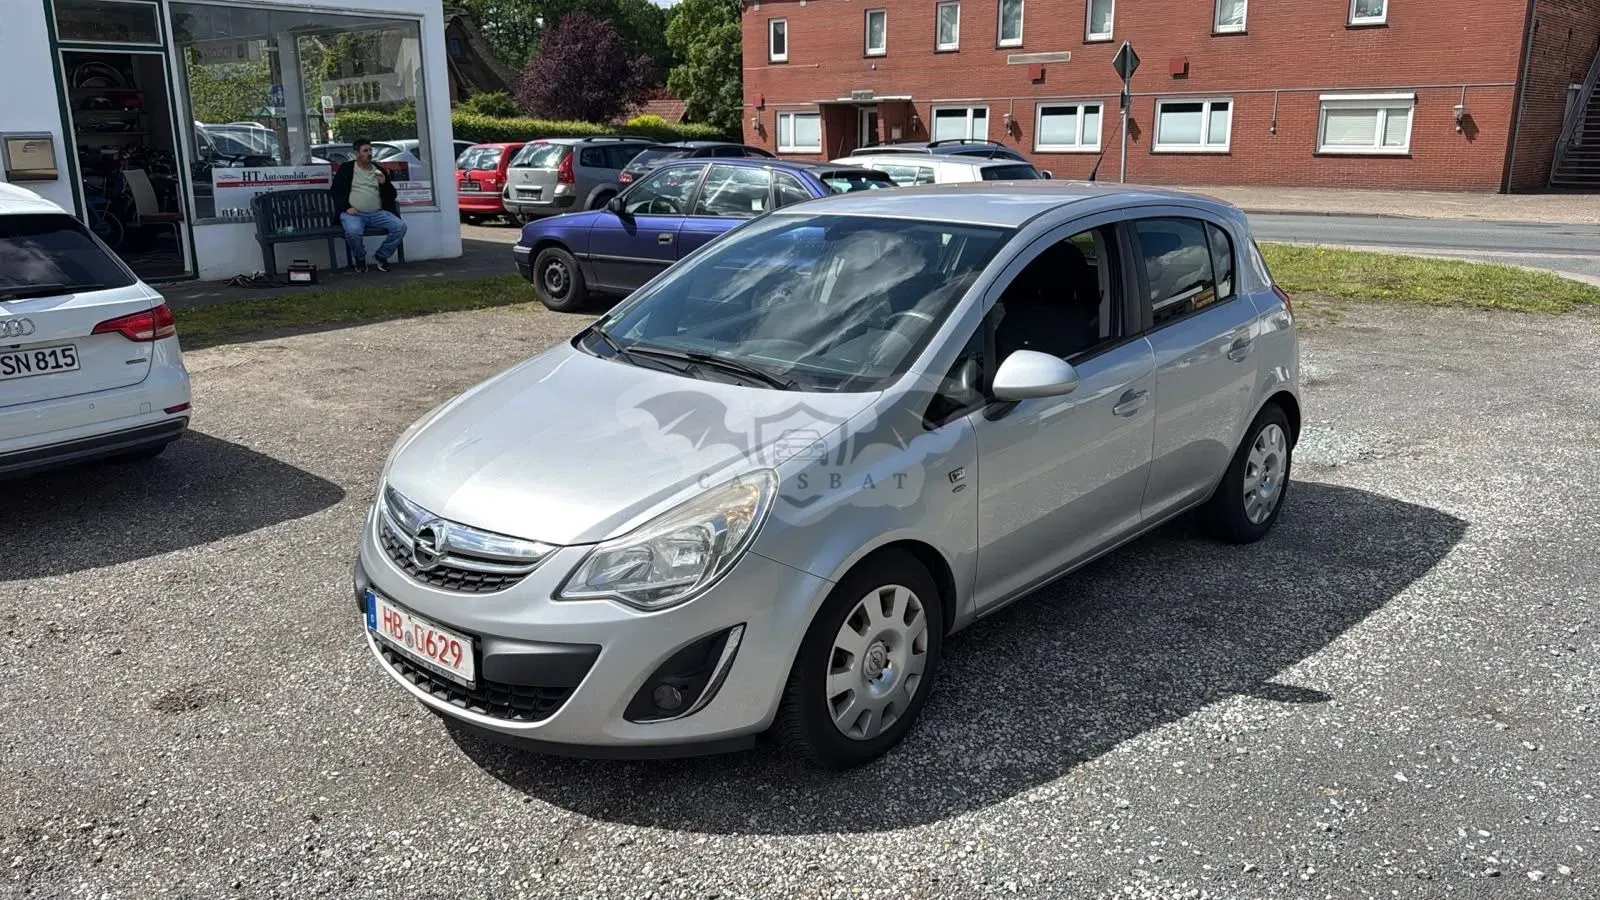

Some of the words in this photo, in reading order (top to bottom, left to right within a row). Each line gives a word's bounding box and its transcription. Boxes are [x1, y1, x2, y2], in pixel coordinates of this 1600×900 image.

[242, 171, 260, 182] HT
[1, 353, 32, 375] SN
[35, 348, 76, 371] 815
[384, 606, 403, 640] HB
